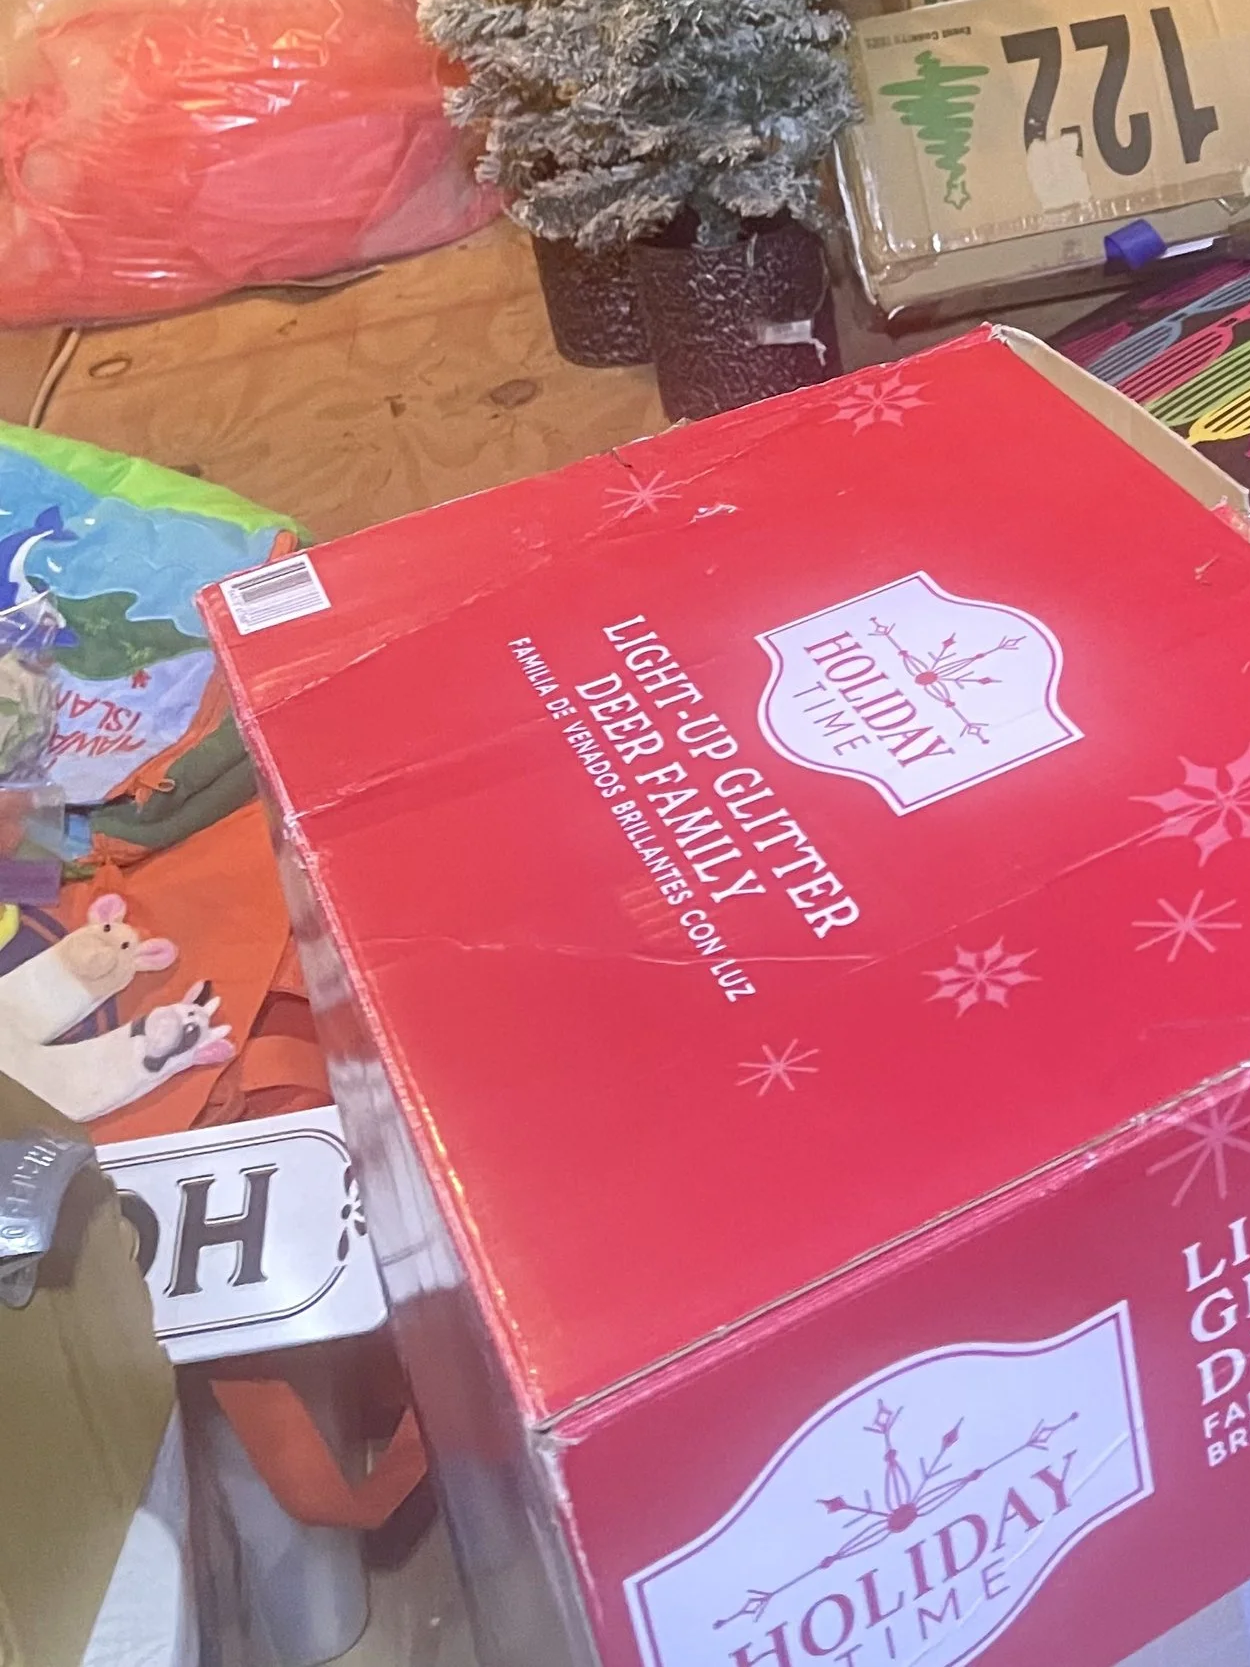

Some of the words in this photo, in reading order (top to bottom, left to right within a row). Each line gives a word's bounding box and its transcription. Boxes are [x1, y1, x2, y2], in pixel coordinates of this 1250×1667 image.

[508, 637, 560, 701] FAMILIA
[545, 692, 577, 721] DE
[804, 631, 955, 768] HOLIDAY
[560, 719, 627, 799] VENADOS
[792, 680, 872, 756] TIME
[575, 672, 664, 765] DEER
[636, 759, 767, 904] FAMILY
[602, 614, 739, 763] LIGHT-UP
[711, 767, 860, 939] GLITTER
[611, 800, 693, 906] BRILLANTES
[680, 909, 726, 957] CON
[709, 959, 756, 1003] LUZ
[728, 1449, 1079, 1667] HOLIDAY
[833, 1558, 1011, 1667] TIME
